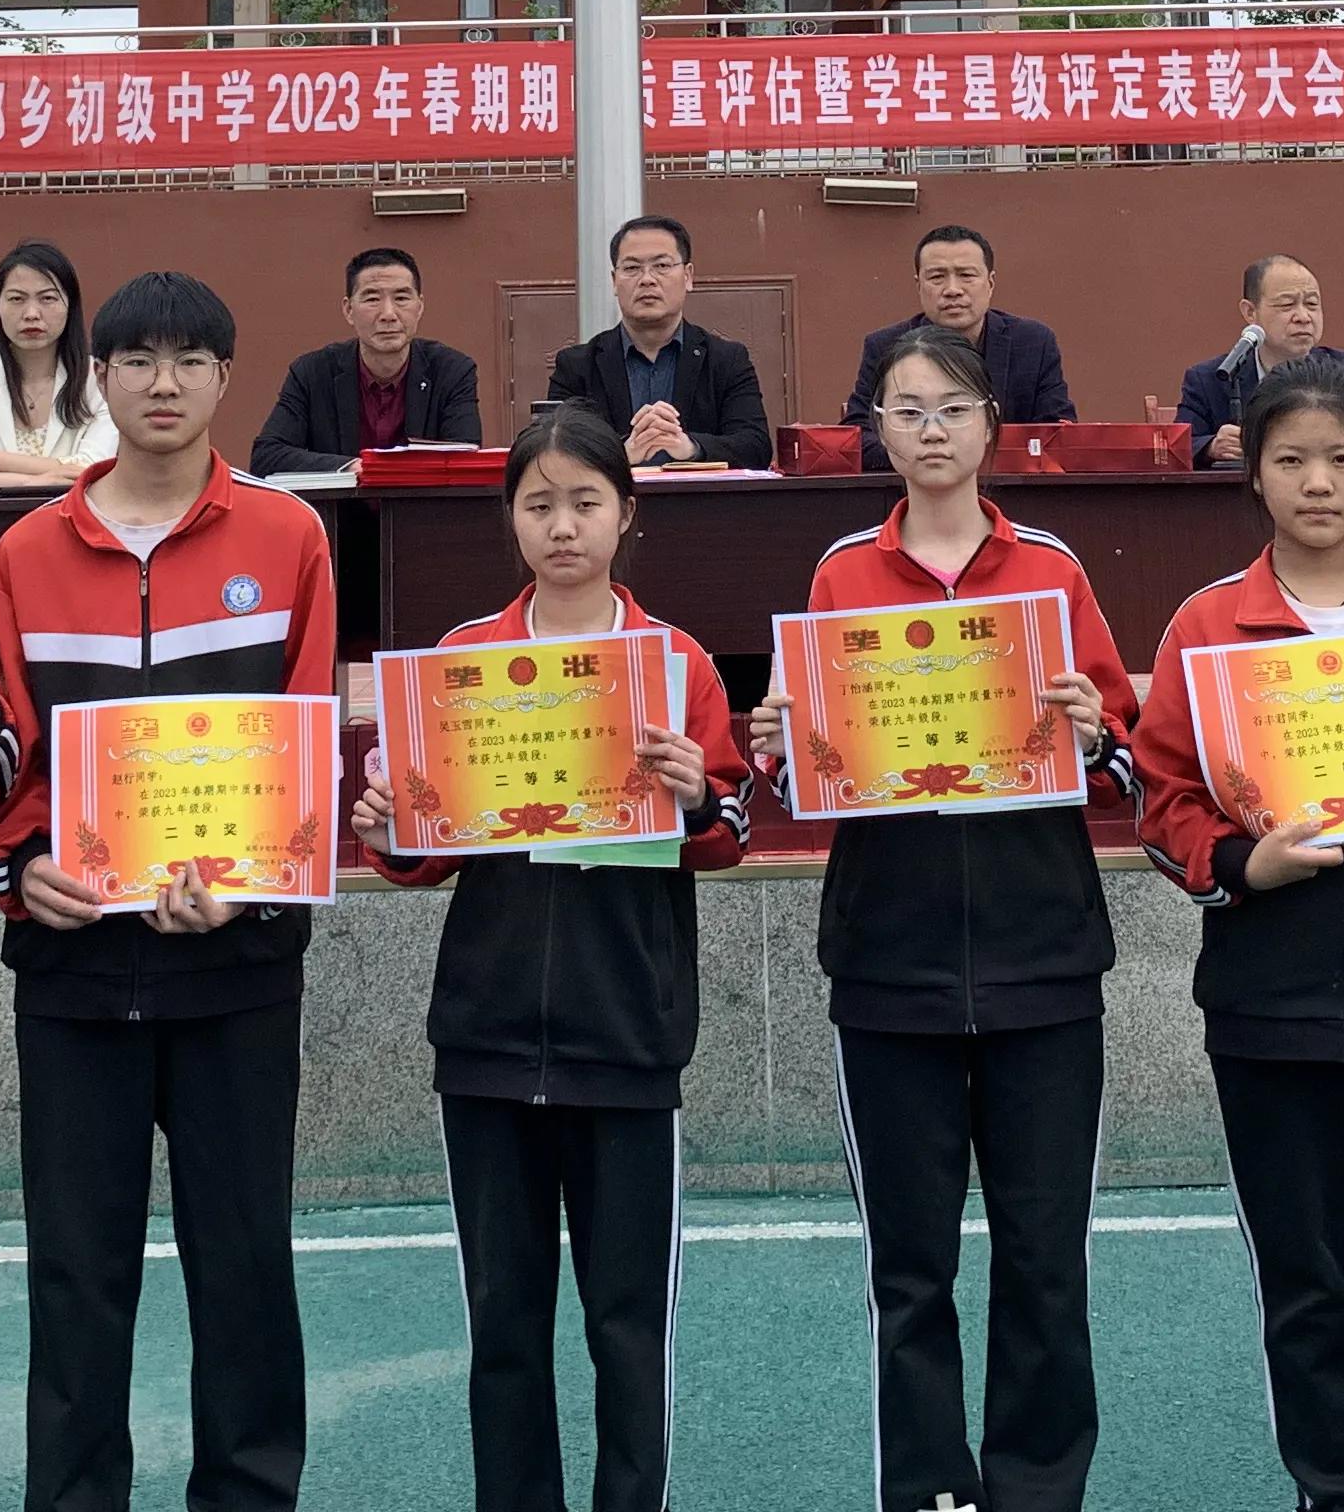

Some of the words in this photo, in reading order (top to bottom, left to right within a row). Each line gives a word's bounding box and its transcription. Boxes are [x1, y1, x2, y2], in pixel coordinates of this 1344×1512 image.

[959, 616, 998, 642] 状
[562, 653, 600, 678] 状
[237, 711, 274, 736] 状
[896, 730, 969, 748] 二等奖
[495, 769, 568, 786] 二等奖
[165, 823, 237, 840] 二等奖
